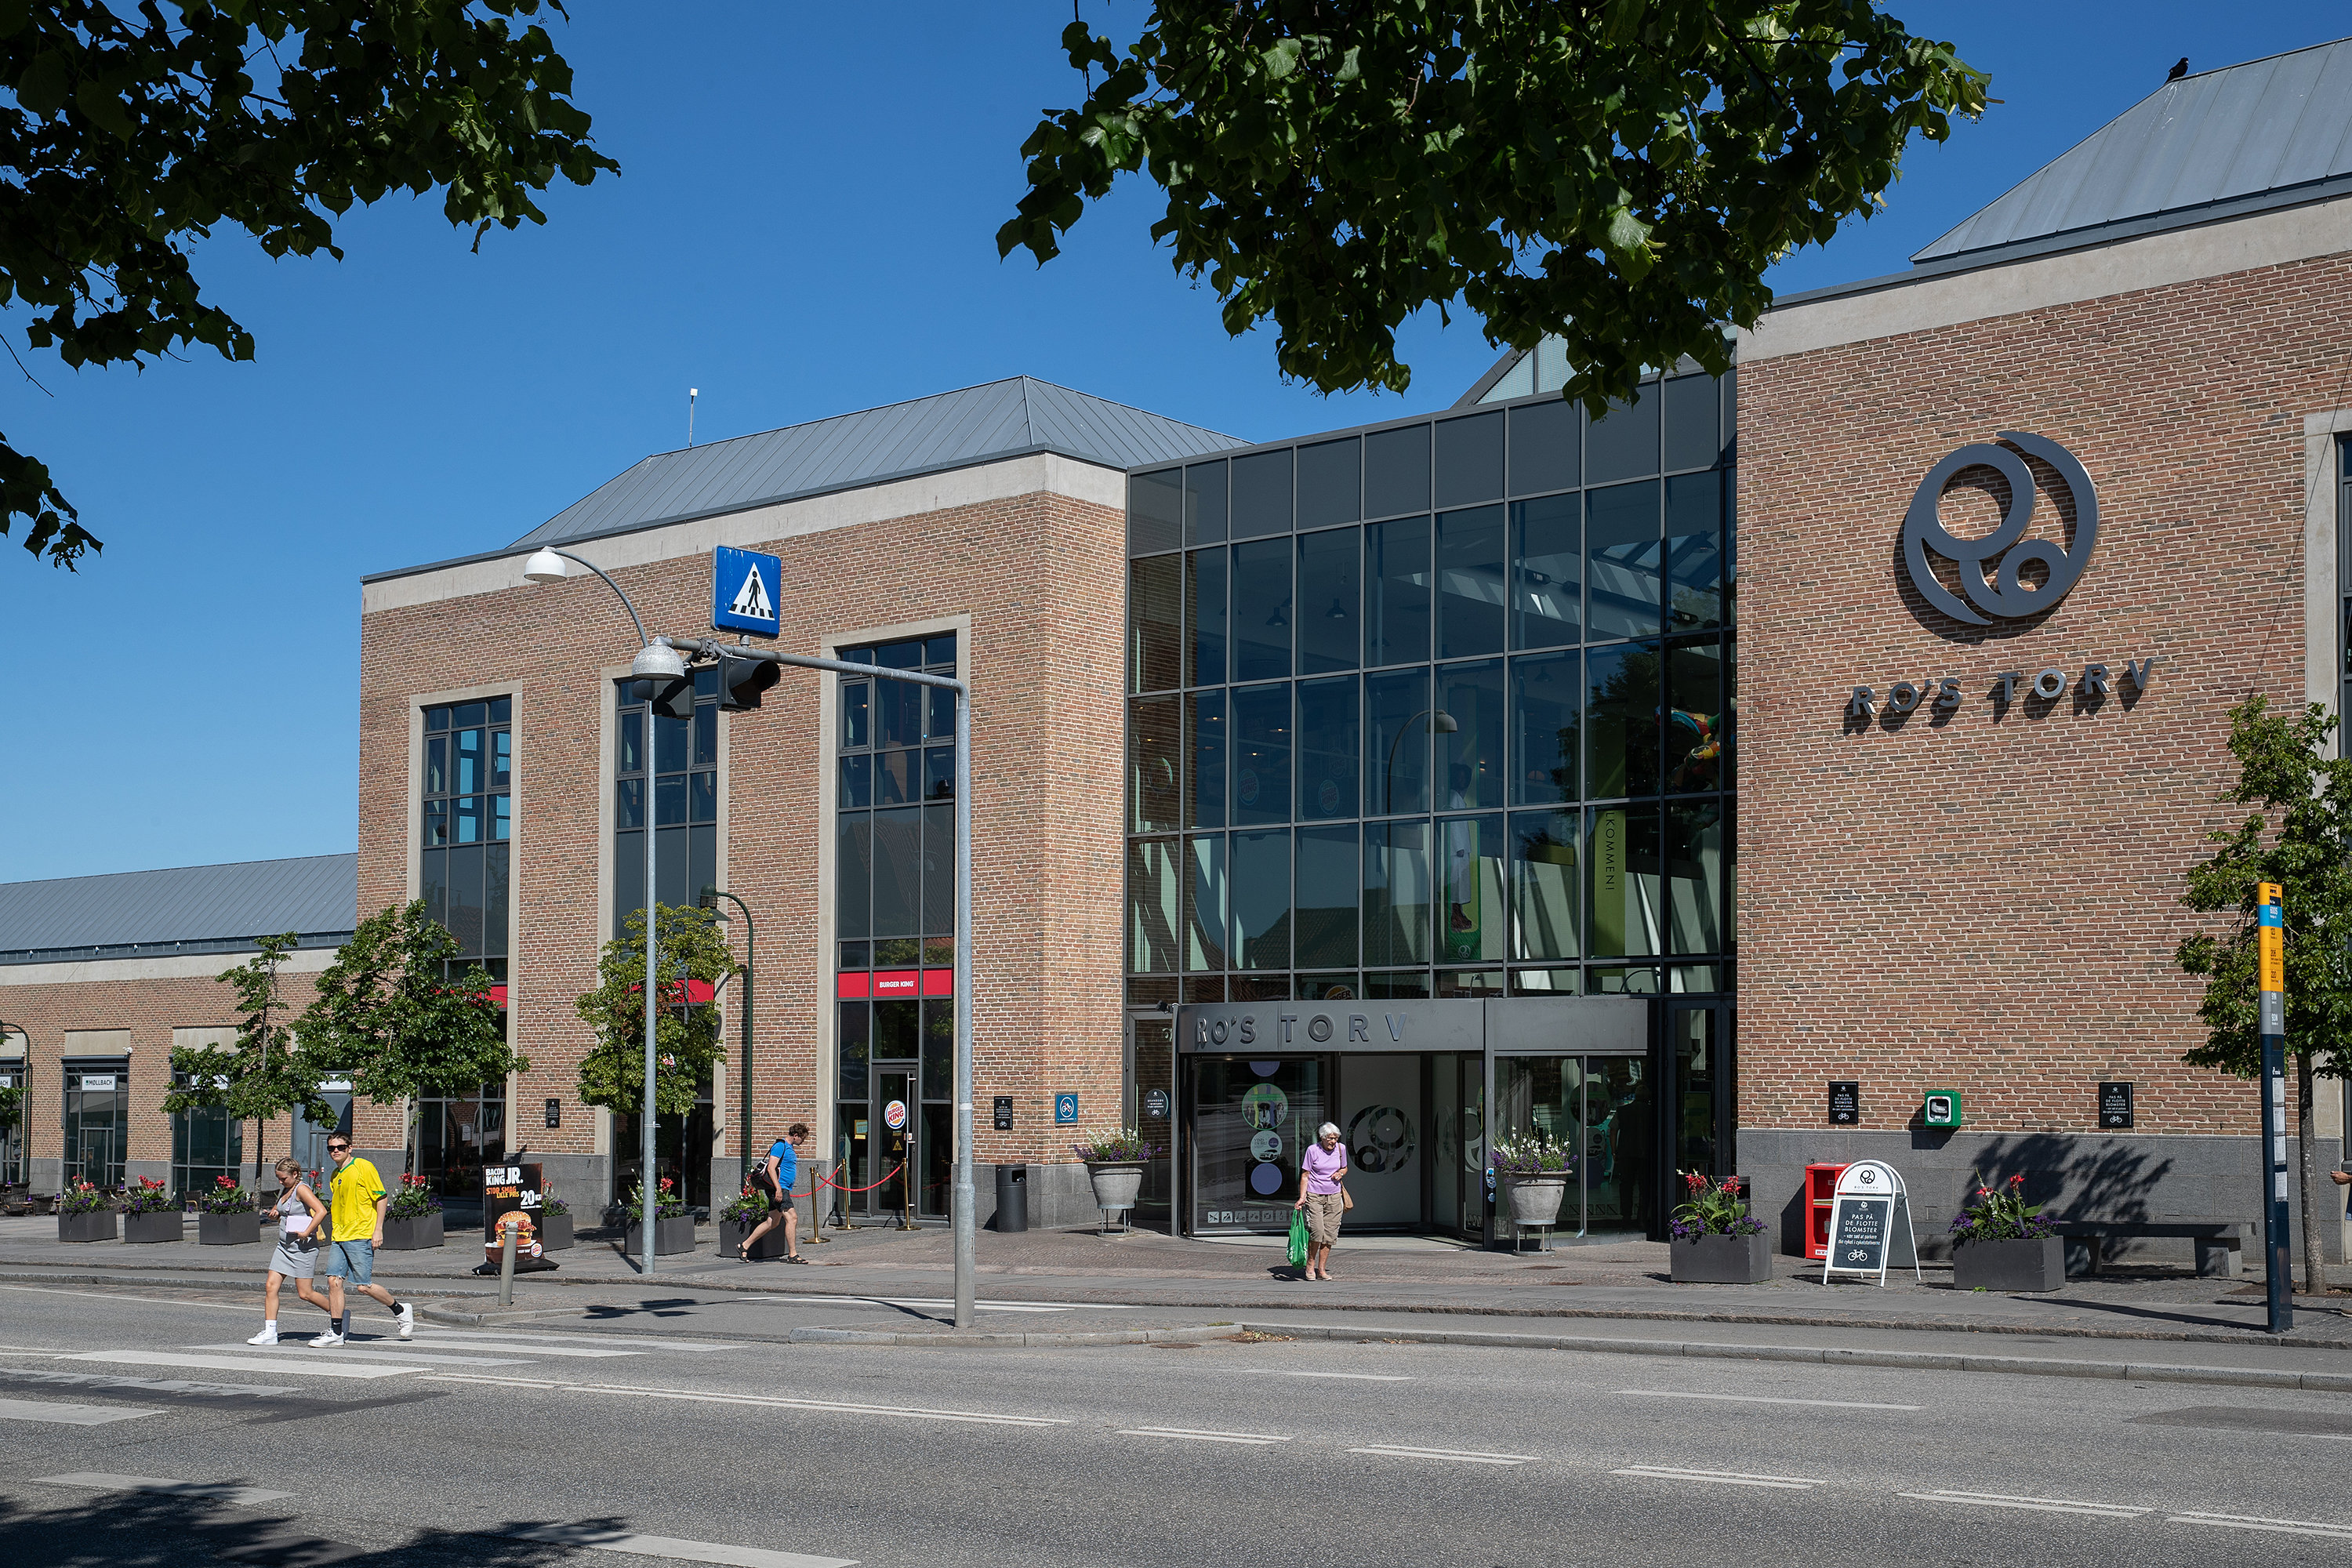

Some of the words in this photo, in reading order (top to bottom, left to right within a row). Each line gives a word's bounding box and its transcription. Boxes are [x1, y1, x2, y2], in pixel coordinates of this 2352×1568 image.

[1853, 677, 1963, 716] RO'S
[1997, 658, 2154, 702] TORV
[1606, 793, 1615, 890] LKOMMEN!
[1197, 1015, 1256, 1044] RO'S
[1281, 1013, 1406, 1042] TORV
[887, 1105, 903, 1116] BURGER
[888, 1110, 904, 1123] KING
[485, 1167, 506, 1177] BACON
[506, 1167, 524, 1185] JR.
[485, 1175, 506, 1186] KING
[501, 1185, 517, 1194] SMAG
[521, 1189, 535, 1206] 20
